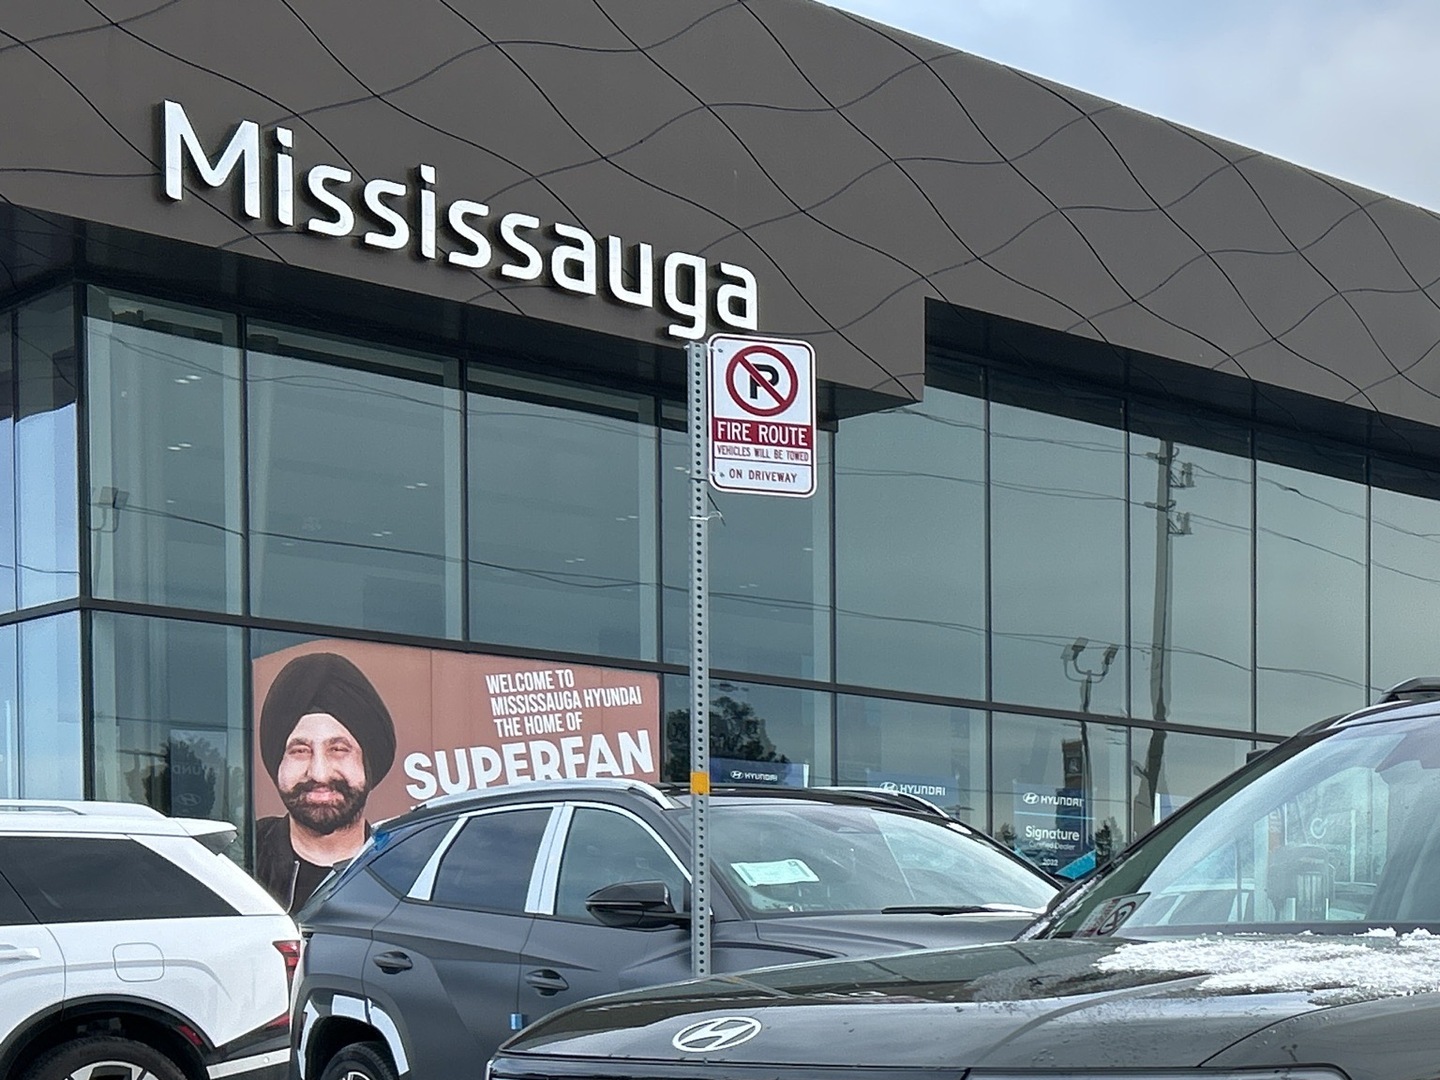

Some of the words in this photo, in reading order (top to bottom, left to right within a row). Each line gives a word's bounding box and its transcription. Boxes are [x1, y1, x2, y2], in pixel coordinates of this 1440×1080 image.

[164, 99, 757, 339] Mississauga
[717, 421, 751, 441] FIRE
[758, 425, 808, 446] ROUTE
[717, 445, 750, 456] VEHICLES
[754, 448, 771, 459] WILL
[773, 450, 784, 460] BE
[787, 450, 809, 462] TOWED
[729, 468, 743, 479] ON
[748, 470, 798, 483] DRIVEWAY
[486, 671, 555, 694] WELCOME
[556, 669, 575, 688] TO
[490, 690, 582, 716] MISSISSAUGA
[583, 686, 643, 709] HYUNDAI
[494, 717, 523, 738] THE
[524, 714, 565, 735] HOME
[565, 712, 583, 731] OF
[403, 730, 654, 800] SUPERFAN
[744, 772, 777, 782] HYUNDAI
[900, 784, 945, 796] HYUNDAI
[1041, 796, 1084, 807] HYUNDAI
[1025, 825, 1080, 841] Signature
